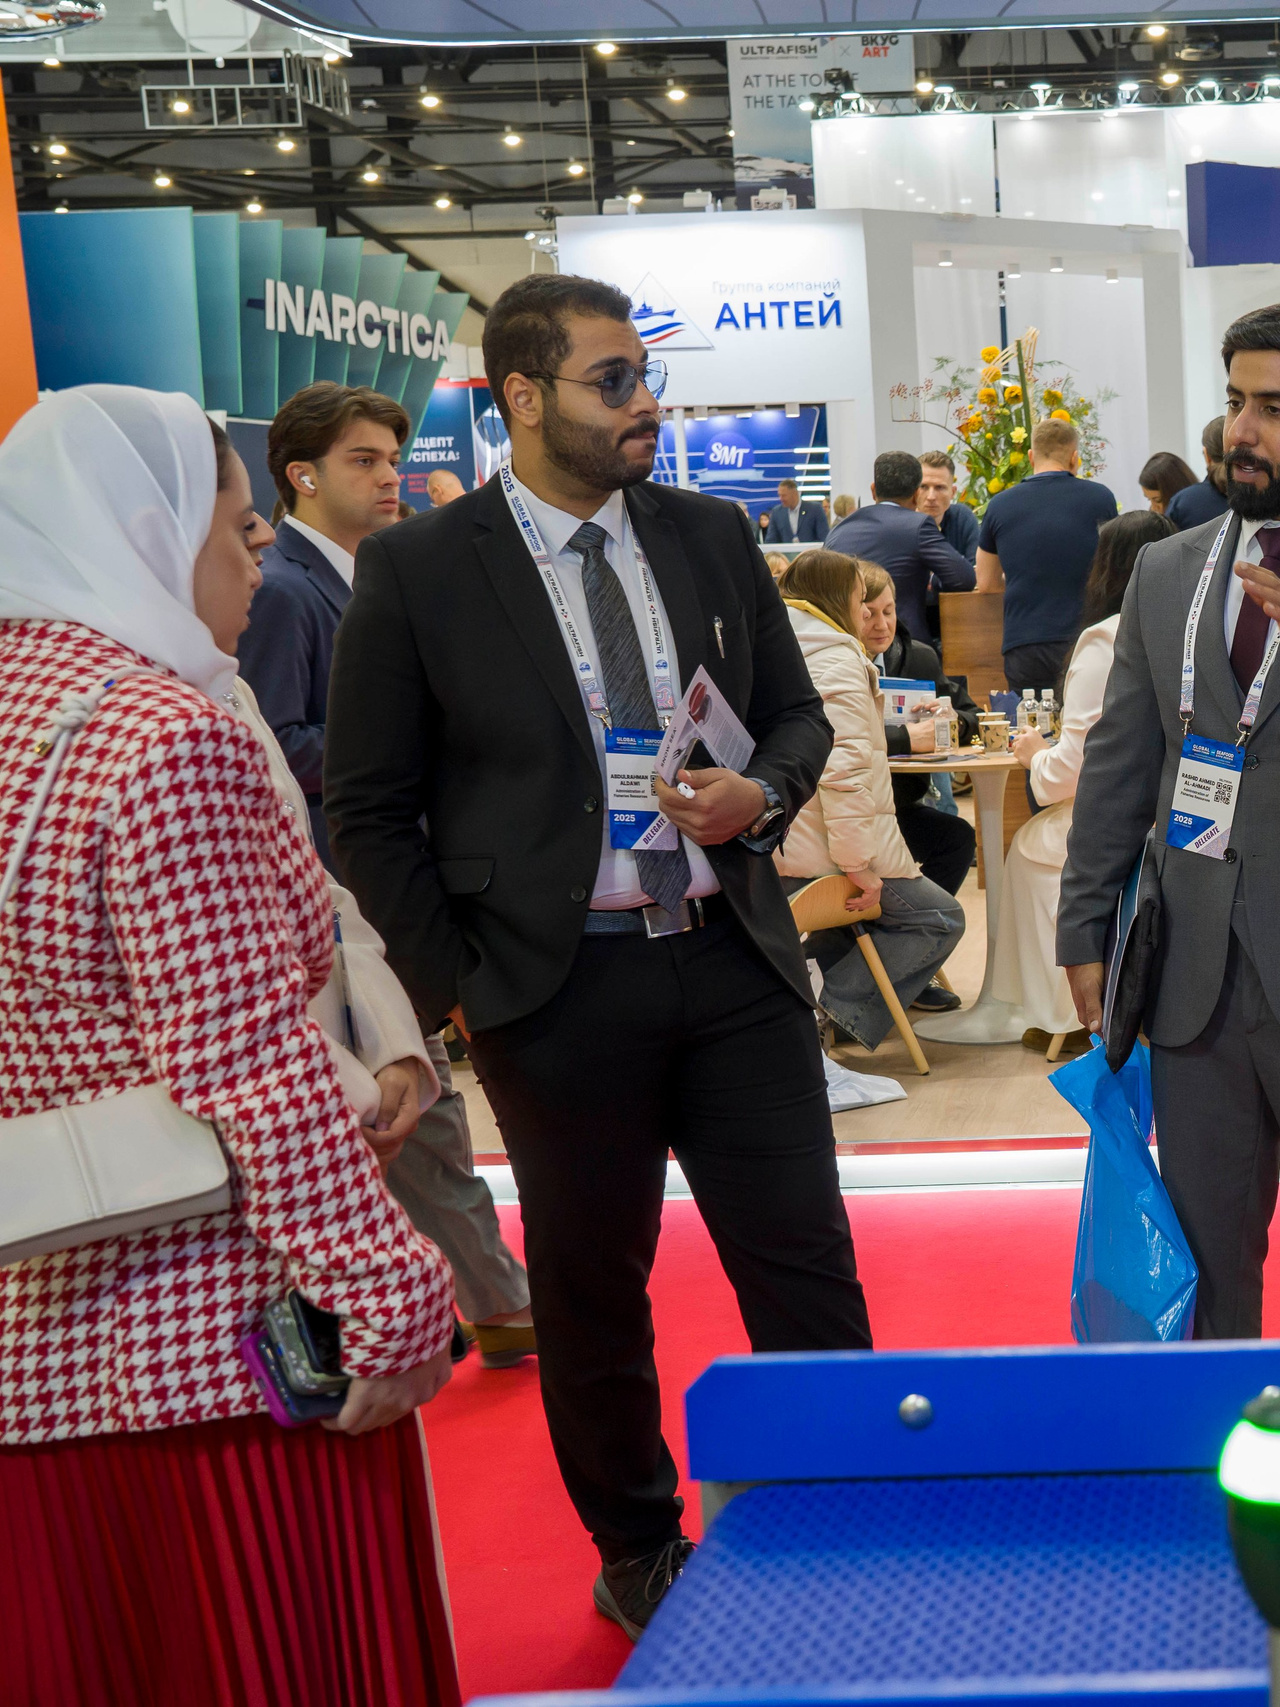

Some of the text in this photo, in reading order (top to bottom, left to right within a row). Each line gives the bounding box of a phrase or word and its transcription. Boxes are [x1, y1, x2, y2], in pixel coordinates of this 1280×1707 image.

[740, 45, 818, 56] ULTRAFISH
[862, 46, 890, 58] ART
[743, 74, 760, 88] AT
[768, 73, 796, 88] THE
[744, 95, 774, 109] THE
[712, 278, 840, 295] Группа компаний
[715, 292, 842, 330] АНТЕЙ
[265, 278, 450, 362] INARCTICA
[709, 442, 750, 468] SMT
[502, 464, 514, 492] 2025
[514, 496, 542, 552] GLOBAL SEAFOOD
[546, 570, 584, 658] ULTRAFISH ULTRAFISH
[652, 618, 662, 654] ULTRAFISH
[1192, 744, 1210, 752] GLOBAL
[1216, 750, 1234, 758] SEAFOOD
[1182, 772, 1198, 782] RASHID
[1198, 776, 1216, 786] AHMED
[1184, 780, 1210, 792] AL-AHMADI
[613, 813, 636, 822] 2025
[1174, 814, 1193, 826] 2025
[642, 816, 667, 845] DELEGATE
[1194, 826, 1220, 849] DELEGATE
